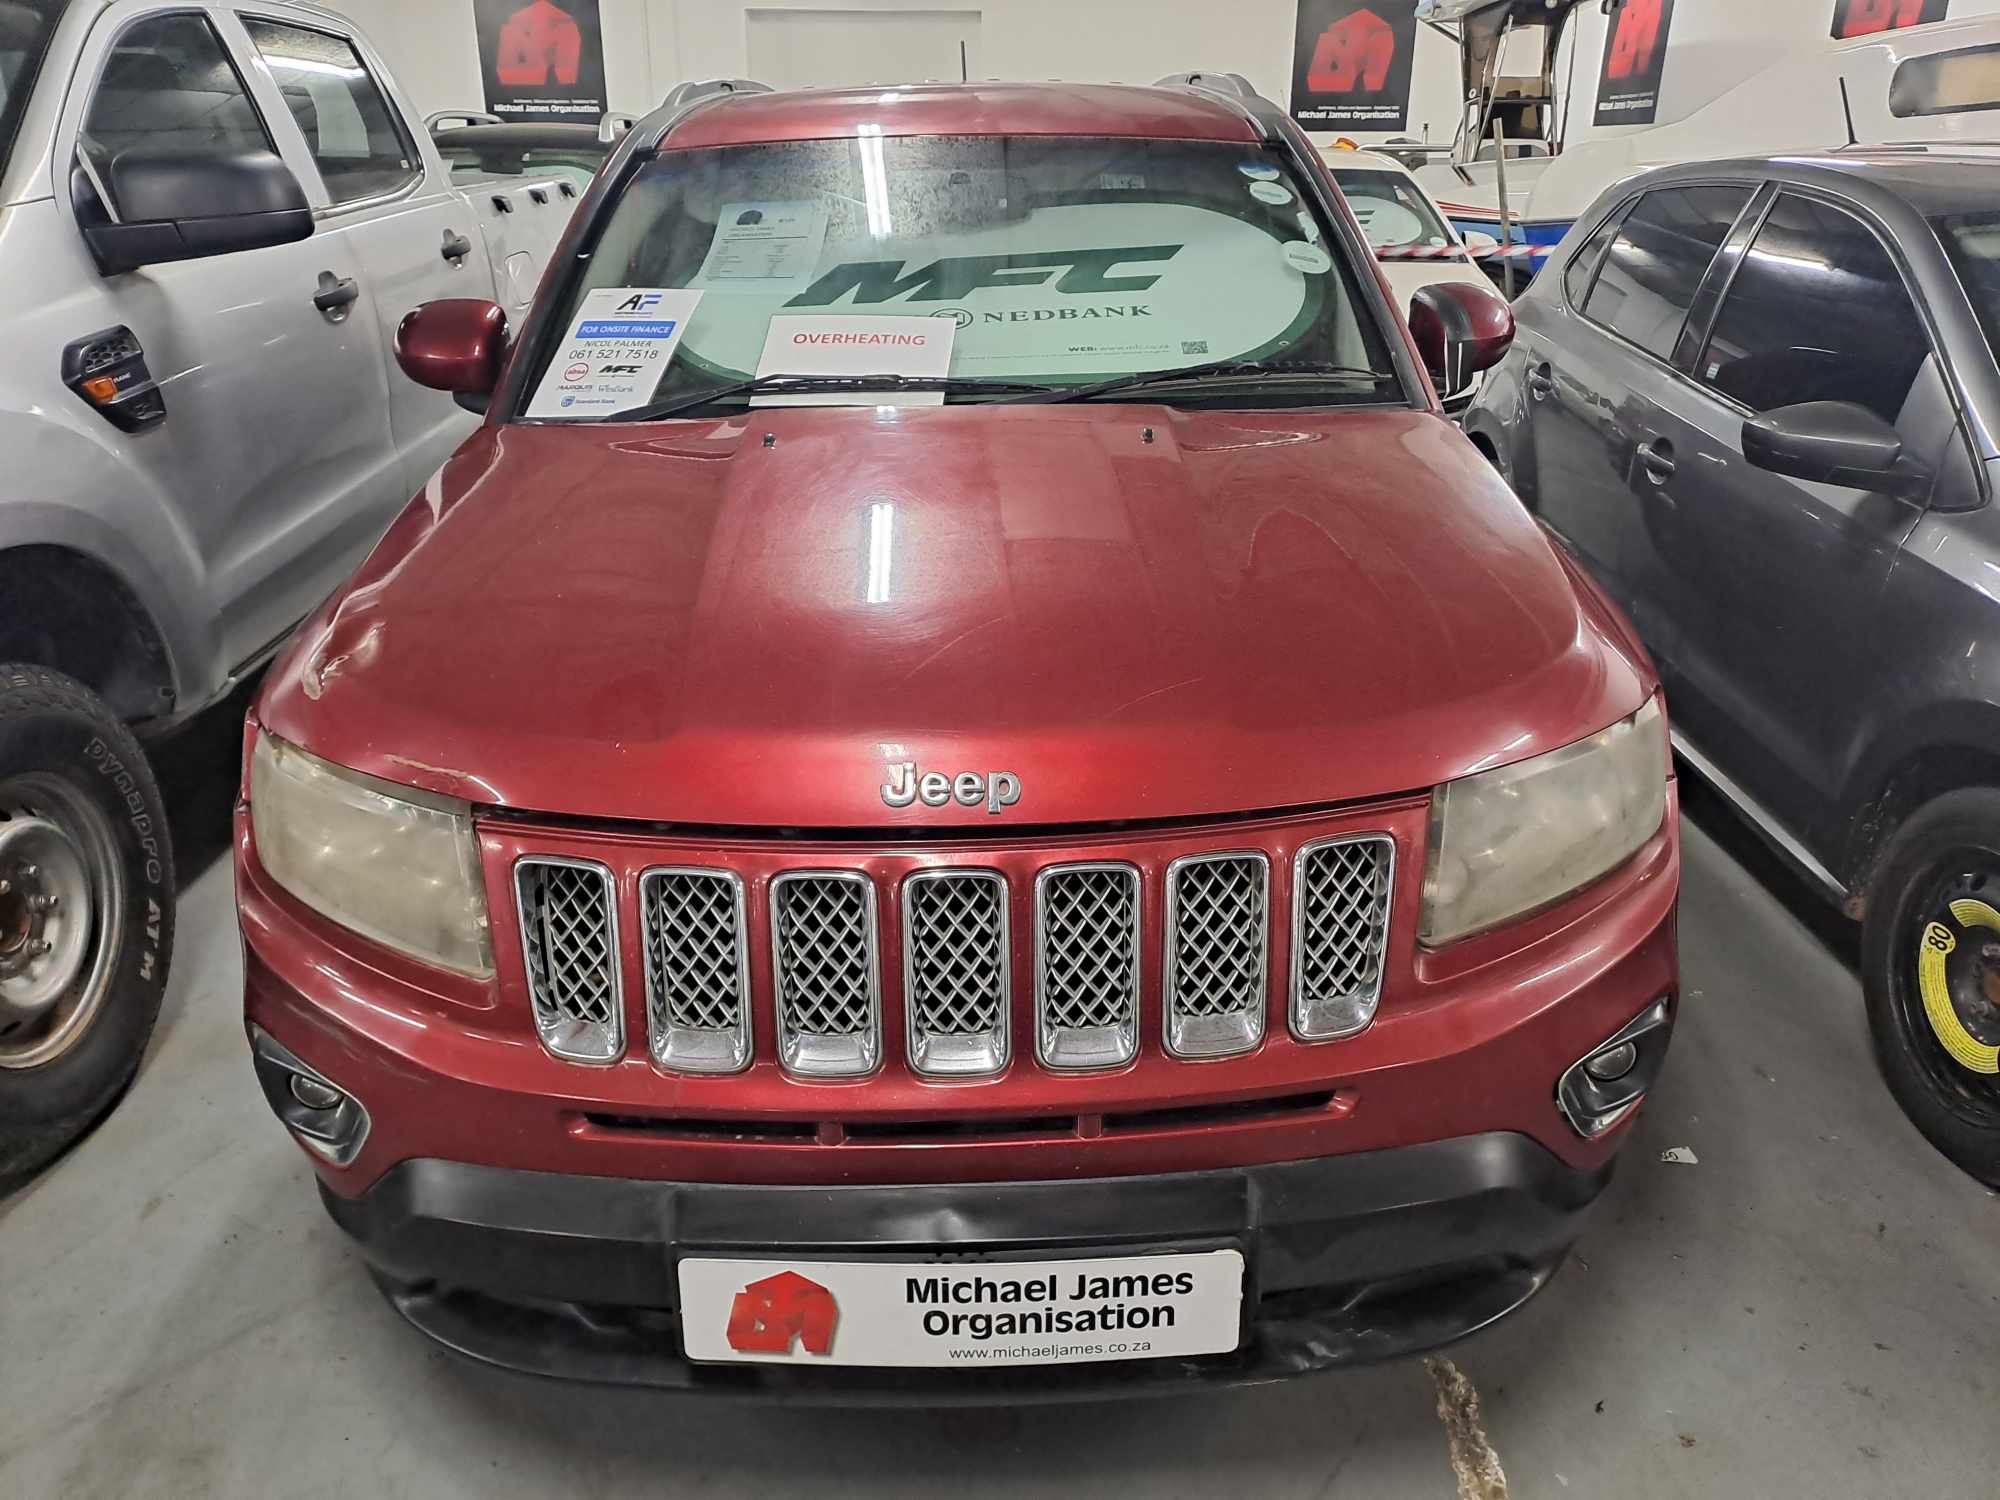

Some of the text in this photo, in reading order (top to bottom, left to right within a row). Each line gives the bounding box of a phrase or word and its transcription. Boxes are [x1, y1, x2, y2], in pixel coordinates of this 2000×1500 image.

[493, 104, 524, 112] Michael
[551, 105, 600, 113] Organisation
[1298, 111, 1400, 120] Michael James Organisation
[781, 244, 1185, 308] MFC
[617, 294, 662, 310] AF
[984, 304, 1153, 323] NEDBANK
[581, 326, 672, 334] FOR ONSITE FINANCE
[792, 332, 927, 347] OVERHEATING
[568, 350, 659, 360] 061 521 7518
[879, 760, 1021, 815] Jeep
[1928, 925, 1951, 951] 80
[905, 1271, 1194, 1304] Michael James
[922, 1302, 1176, 1341] Organisation
[948, 1340, 1152, 1359] www.michaeljames.co.za
